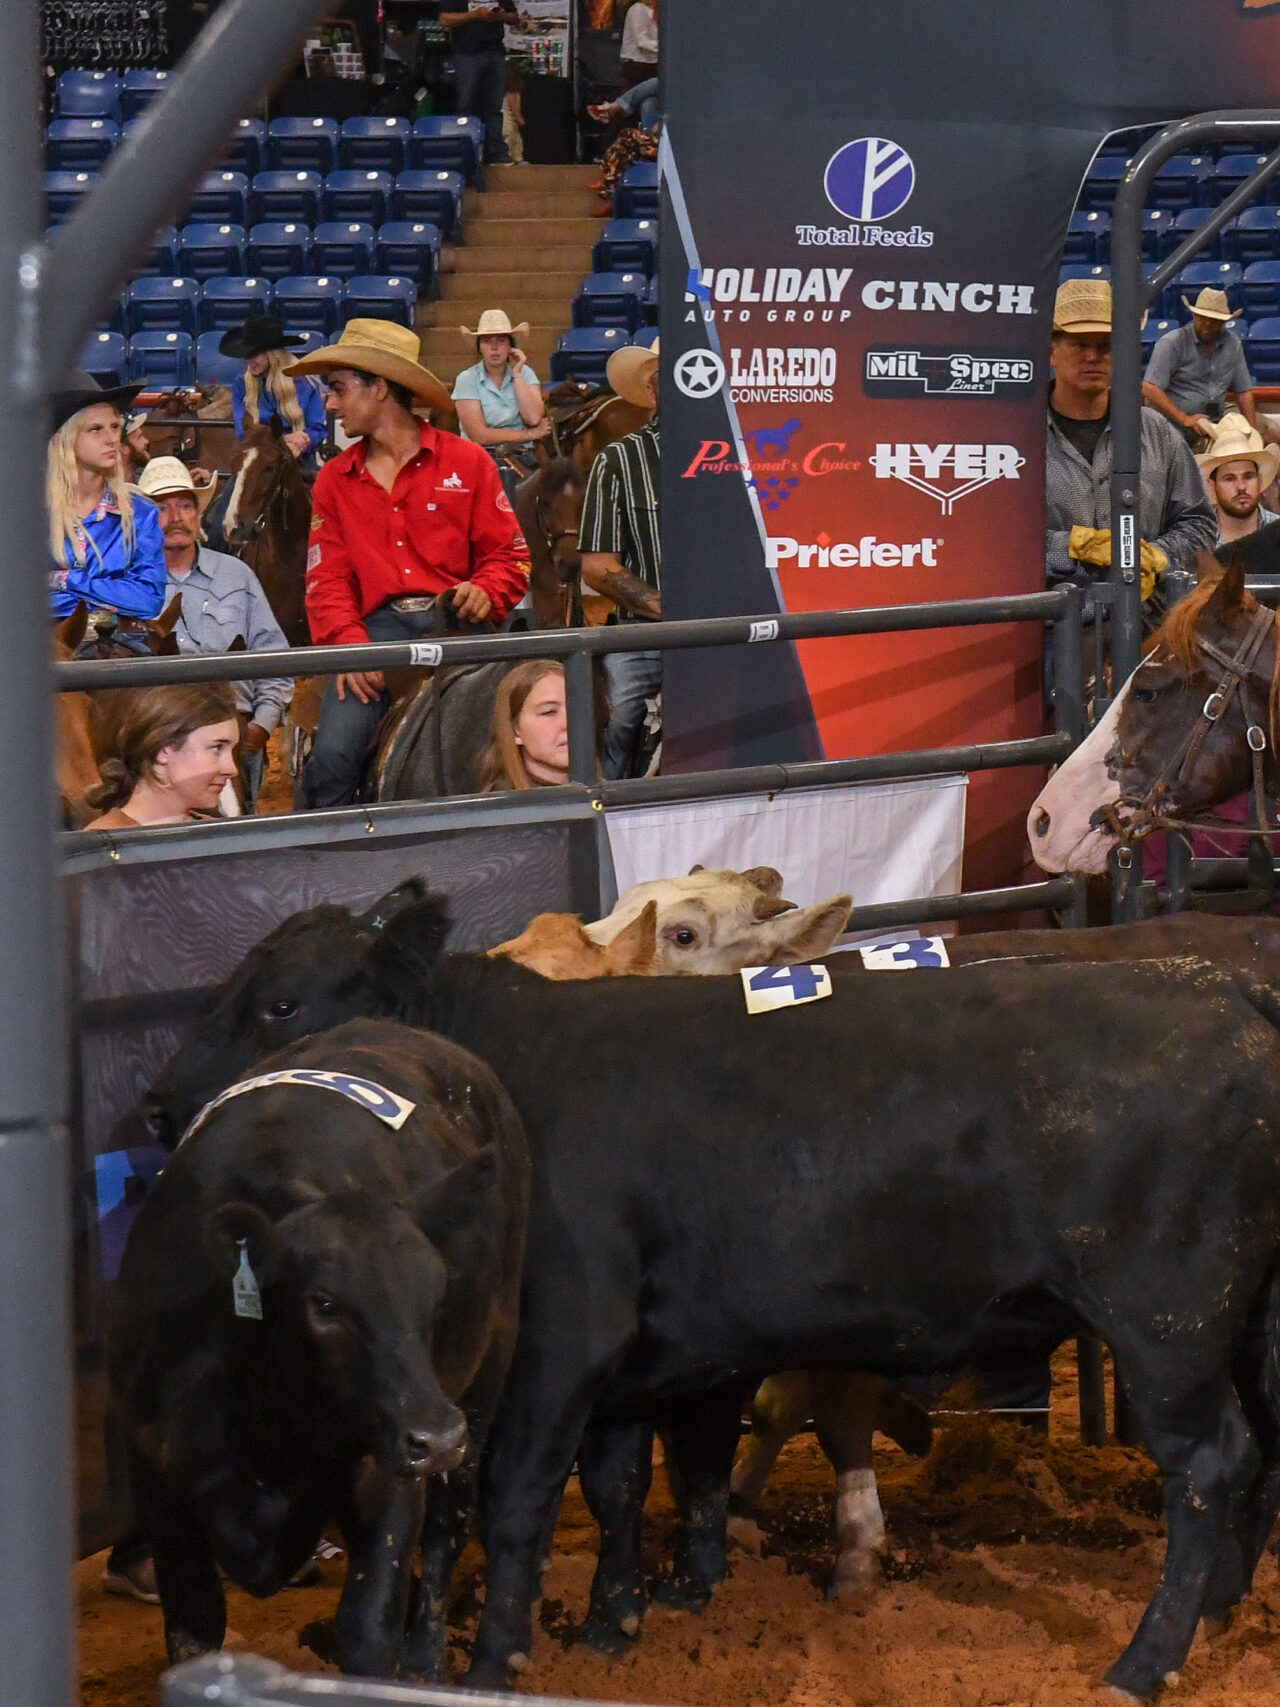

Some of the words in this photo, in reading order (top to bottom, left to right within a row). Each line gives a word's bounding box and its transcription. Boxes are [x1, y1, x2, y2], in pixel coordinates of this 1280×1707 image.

[795, 225, 859, 246] Total
[862, 226, 934, 247] Feeds
[685, 268, 854, 303] HOLIDAY
[861, 280, 1035, 315] CINCH
[685, 309, 751, 323] AUTO
[767, 309, 852, 323] GROUP
[730, 347, 837, 387] LAREDO
[869, 354, 919, 377] Mil
[949, 355, 1031, 381] Spec
[729, 388, 834, 403] CONVERSIONS
[945, 378, 986, 392] Liner
[681, 440, 798, 478] Professional's
[802, 442, 861, 477] Choice
[875, 444, 1021, 479] HYER
[765, 532, 938, 568] Priefert
[750, 965, 824, 999] 4
